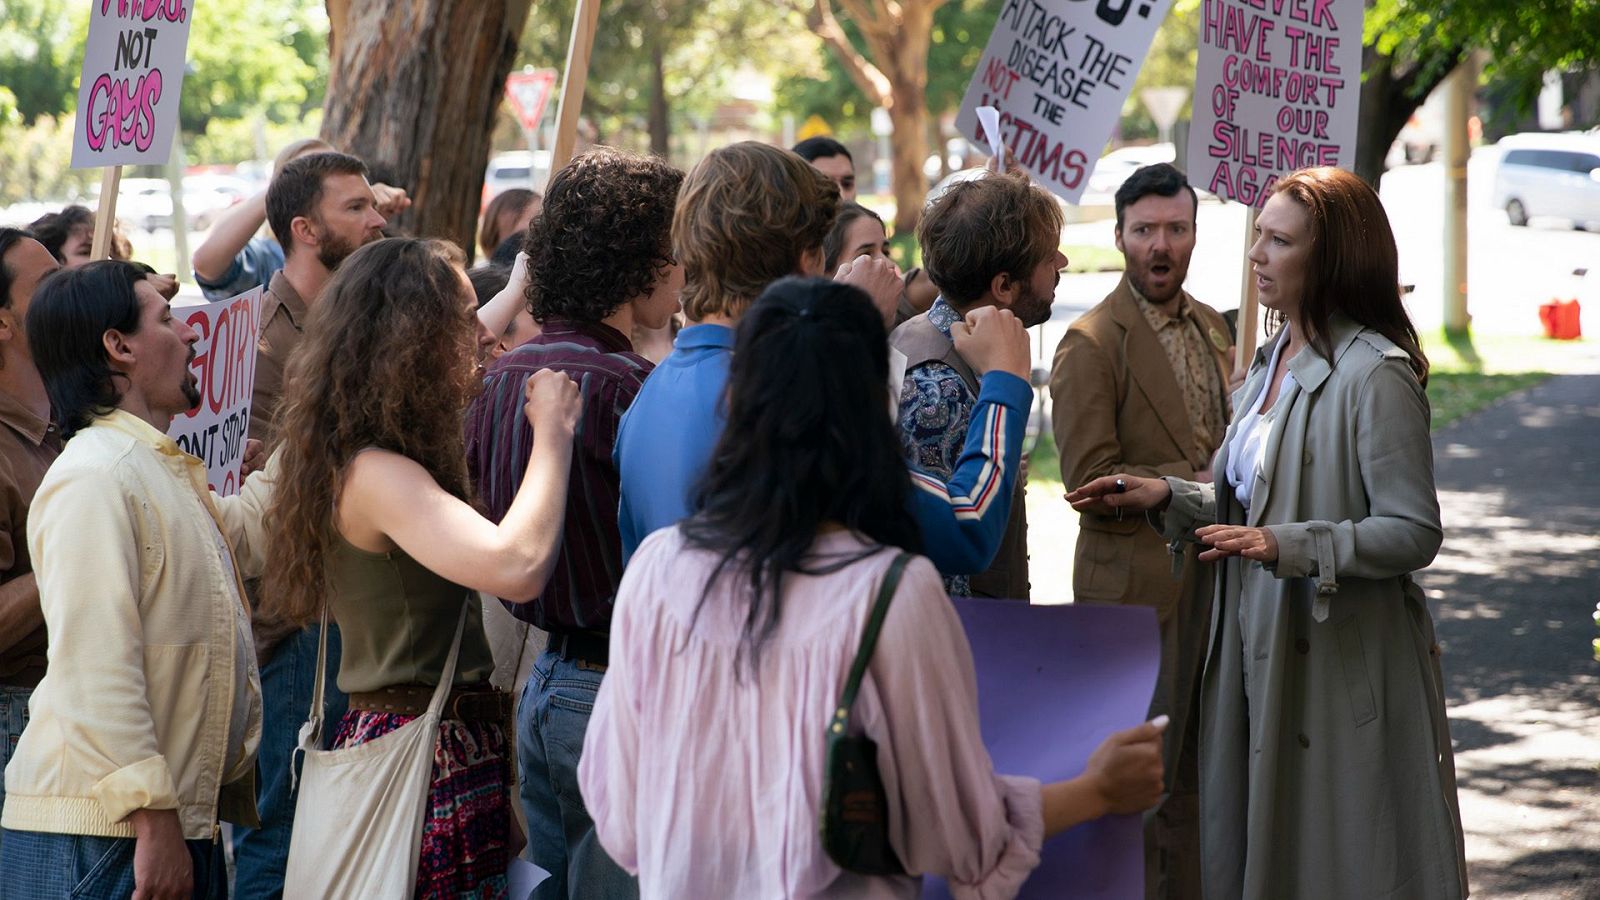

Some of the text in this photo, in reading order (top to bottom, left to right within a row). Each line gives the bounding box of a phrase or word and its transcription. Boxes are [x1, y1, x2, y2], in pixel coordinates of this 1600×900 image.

[114, 28, 158, 71] NOT
[1001, 0, 1075, 60] ATTACK
[1079, 34, 1132, 90] THE
[1204, 0, 1274, 62] HAVE
[1285, 26, 1341, 75] THE
[982, 58, 1065, 125] NOT THE
[1008, 40, 1096, 109] DISEASE
[1223, 54, 1344, 108] COMFORT
[86, 68, 163, 153] GAYS
[974, 94, 1087, 190] CTIMS
[1212, 84, 1329, 140] OF OUR
[1209, 120, 1340, 171] SILENCE
[170, 290, 263, 418] GOTRY
[220, 407, 248, 467] STOP
